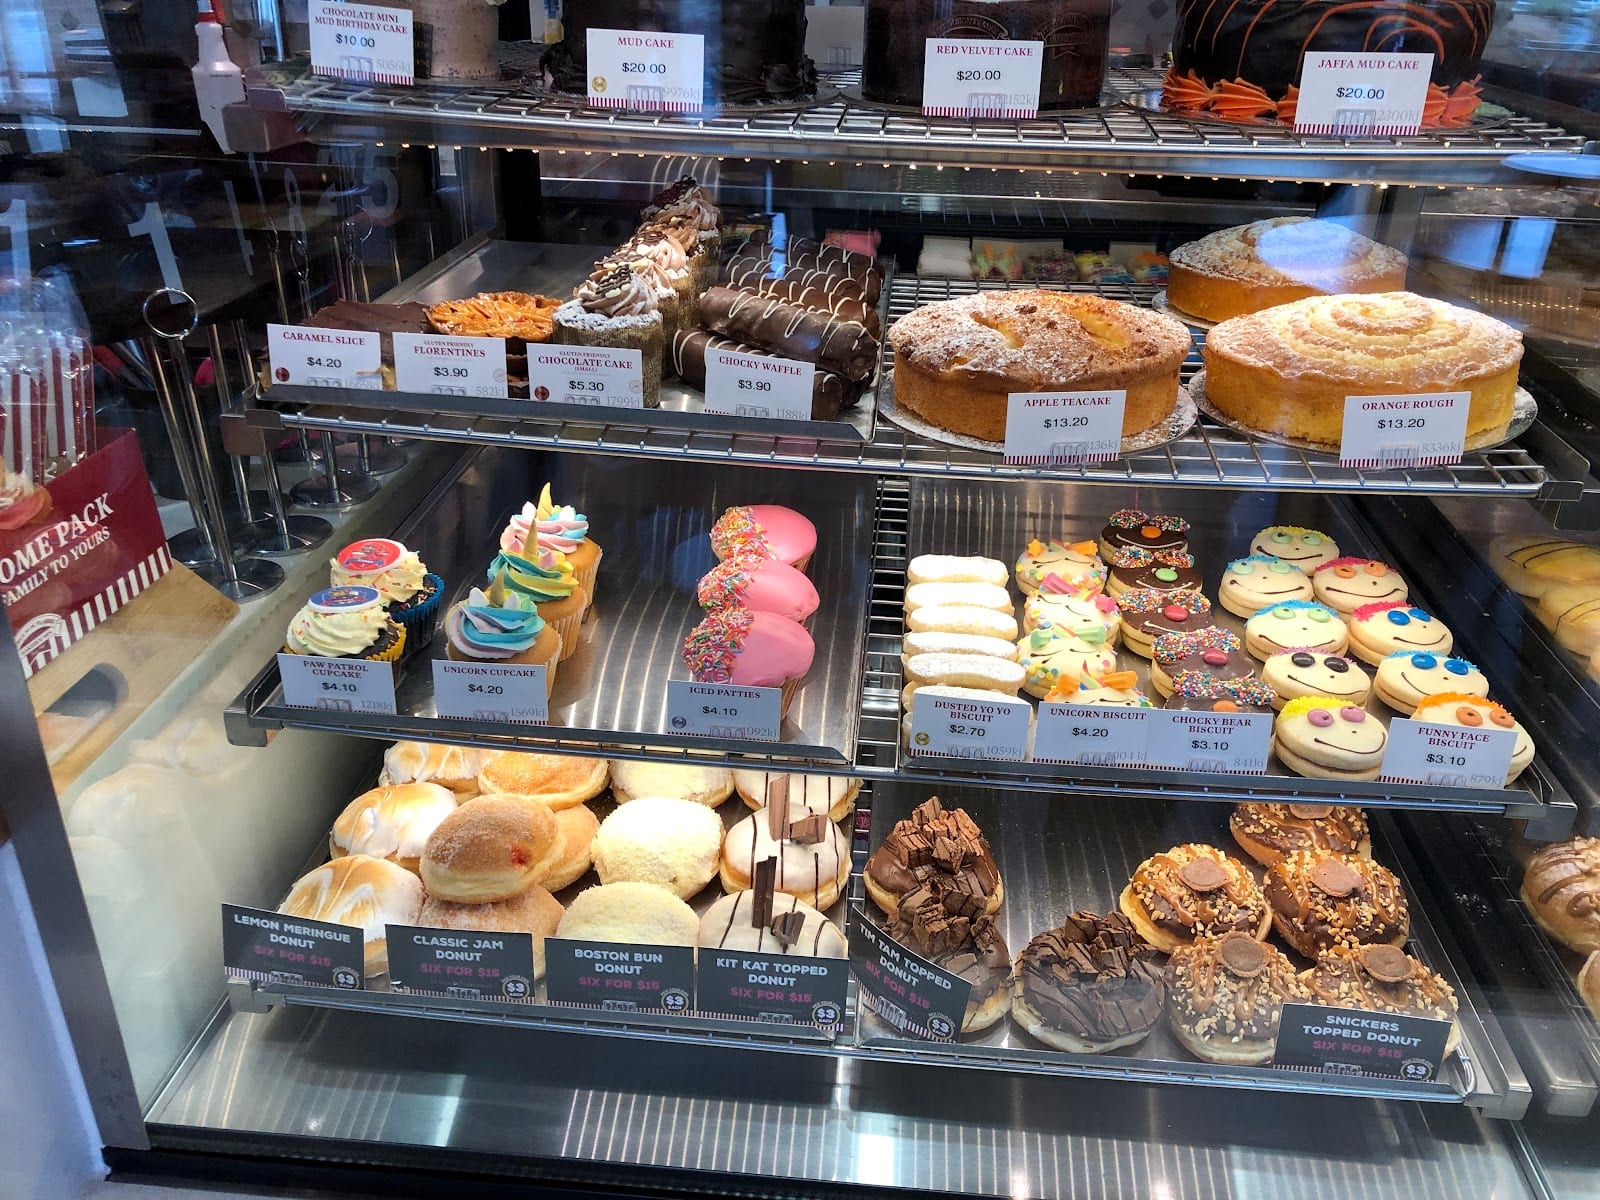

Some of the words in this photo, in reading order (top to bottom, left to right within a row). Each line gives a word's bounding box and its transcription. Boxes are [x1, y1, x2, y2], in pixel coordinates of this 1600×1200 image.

[322, 7, 375, 21] CHOCOLATE
[377, 13, 399, 23] MINI
[315, 15, 335, 26] MUD
[336, 18, 382, 31] BIRTHDAY
[383, 24, 408, 34] CAKE
[335, 33, 376, 48] $10.00
[617, 36, 643, 47] MUD
[645, 38, 675, 49] CAKE
[936, 45, 959, 54] RED
[961, 46, 1002, 56] VELVET
[1004, 47, 1033, 57] CAKE
[622, 62, 666, 74] $20.00
[1318, 59, 1355, 69] JAFFA
[1357, 60, 1386, 70] MUD
[1387, 60, 1420, 70] CAKE
[957, 70, 1001, 82] $20.00
[1336, 87, 1385, 100] $20.00
[283, 331, 334, 344] CARAMEL
[335, 336, 365, 346] SLICE
[414, 346, 486, 358] FLORENTINES
[307, 356, 342, 368] $4.20
[538, 356, 602, 367] CHOCOLATE
[604, 360, 633, 370] CAKE
[719, 355, 760, 370] CHOCKY
[762, 363, 802, 376] WAFFLE
[433, 366, 468, 378] $3.90
[569, 380, 604, 392] $5.30
[738, 379, 771, 392] $3.90
[1024, 398, 1059, 407] APPLE
[1061, 397, 1112, 406] TEACAKE
[1362, 401, 1410, 410] ORANGE
[1413, 399, 1454, 409] ROUGH
[1043, 416, 1089, 429] $13.20
[1377, 418, 1425, 429] $13.20
[54, 492, 114, 547] PACK
[2, 566, 48, 606] AMILY
[50, 554, 69, 576] TO
[71, 526, 111, 561] YOURS
[303, 660, 325, 668] PAW
[328, 663, 369, 672] PATROL
[444, 666, 488, 675] UNICORN
[490, 669, 536, 677] CUPCAKE
[312, 669, 362, 679] CUPCAKE
[322, 682, 357, 692] $4.10
[468, 683, 503, 695] $4.20
[689, 686, 715, 695] ICED
[717, 689, 761, 699] PATTIES
[702, 706, 738, 716] $4.10
[934, 701, 977, 712] DUSTED
[980, 706, 994, 714] YO
[1050, 708, 1100, 718] UNICORN
[1103, 711, 1147, 720] BISCUIT
[950, 711, 994, 722] BISCUIT
[1172, 716, 1220, 725] CHOCKY
[1222, 718, 1252, 727] BEAR
[949, 724, 986, 737] $2.70
[1072, 727, 1109, 737] $4.20
[1188, 725, 1234, 735] BISCUIT
[1418, 727, 1459, 739] FUNNY
[1461, 732, 1490, 742] FACE
[1191, 740, 1229, 751] $3.10
[1428, 737, 1476, 750] BISCUIT
[1426, 753, 1466, 766] $3.10
[234, 914, 280, 931] LEMON
[283, 923, 351, 943] MERINGUE
[269, 933, 315, 949] DONUT
[413, 935, 469, 948] CLASSIC
[473, 939, 504, 950] JAM
[254, 945, 274, 957] SIX
[279, 951, 305, 962] FOR
[310, 955, 332, 967] $15
[435, 950, 483, 962] DONUT
[574, 949, 630, 962] BOSTON
[633, 952, 663, 963] BUN
[860, 923, 876, 944] TIM
[878, 939, 900, 962] TAM
[904, 957, 952, 990] TOPPED
[420, 963, 442, 974] SIX
[446, 965, 473, 977] FOR
[478, 967, 500, 978] $15
[594, 963, 643, 975] DONUT
[716, 958, 738, 969] KIT
[742, 960, 769, 971] KAT
[773, 963, 828, 976] TOPPED
[879, 955, 920, 987] DONUT
[337, 972, 355, 985] $3
[578, 976, 600, 987] SIX
[605, 978, 633, 989] FOR
[637, 980, 660, 990] $15
[748, 974, 797, 986] DONUT
[865, 960, 881, 979] SIX
[883, 975, 906, 997] FOR
[909, 992, 931, 1009] $15
[507, 982, 525, 993] $3
[666, 995, 684, 1006] $3
[730, 987, 752, 997] SIX
[757, 990, 785, 1001] FOR
[789, 992, 813, 1003] $15
[817, 1009, 835, 1019] $3
[932, 1019, 950, 1033] $3
[1326, 1015, 1400, 1032] SNICKERS
[1303, 1025, 1362, 1039] TOPPED
[1367, 1032, 1422, 1047] DONUT
[1312, 1040, 1336, 1050] SIX
[1341, 1043, 1372, 1054] FOR
[1378, 1047, 1403, 1058] $15
[1406, 1064, 1426, 1075] $3
